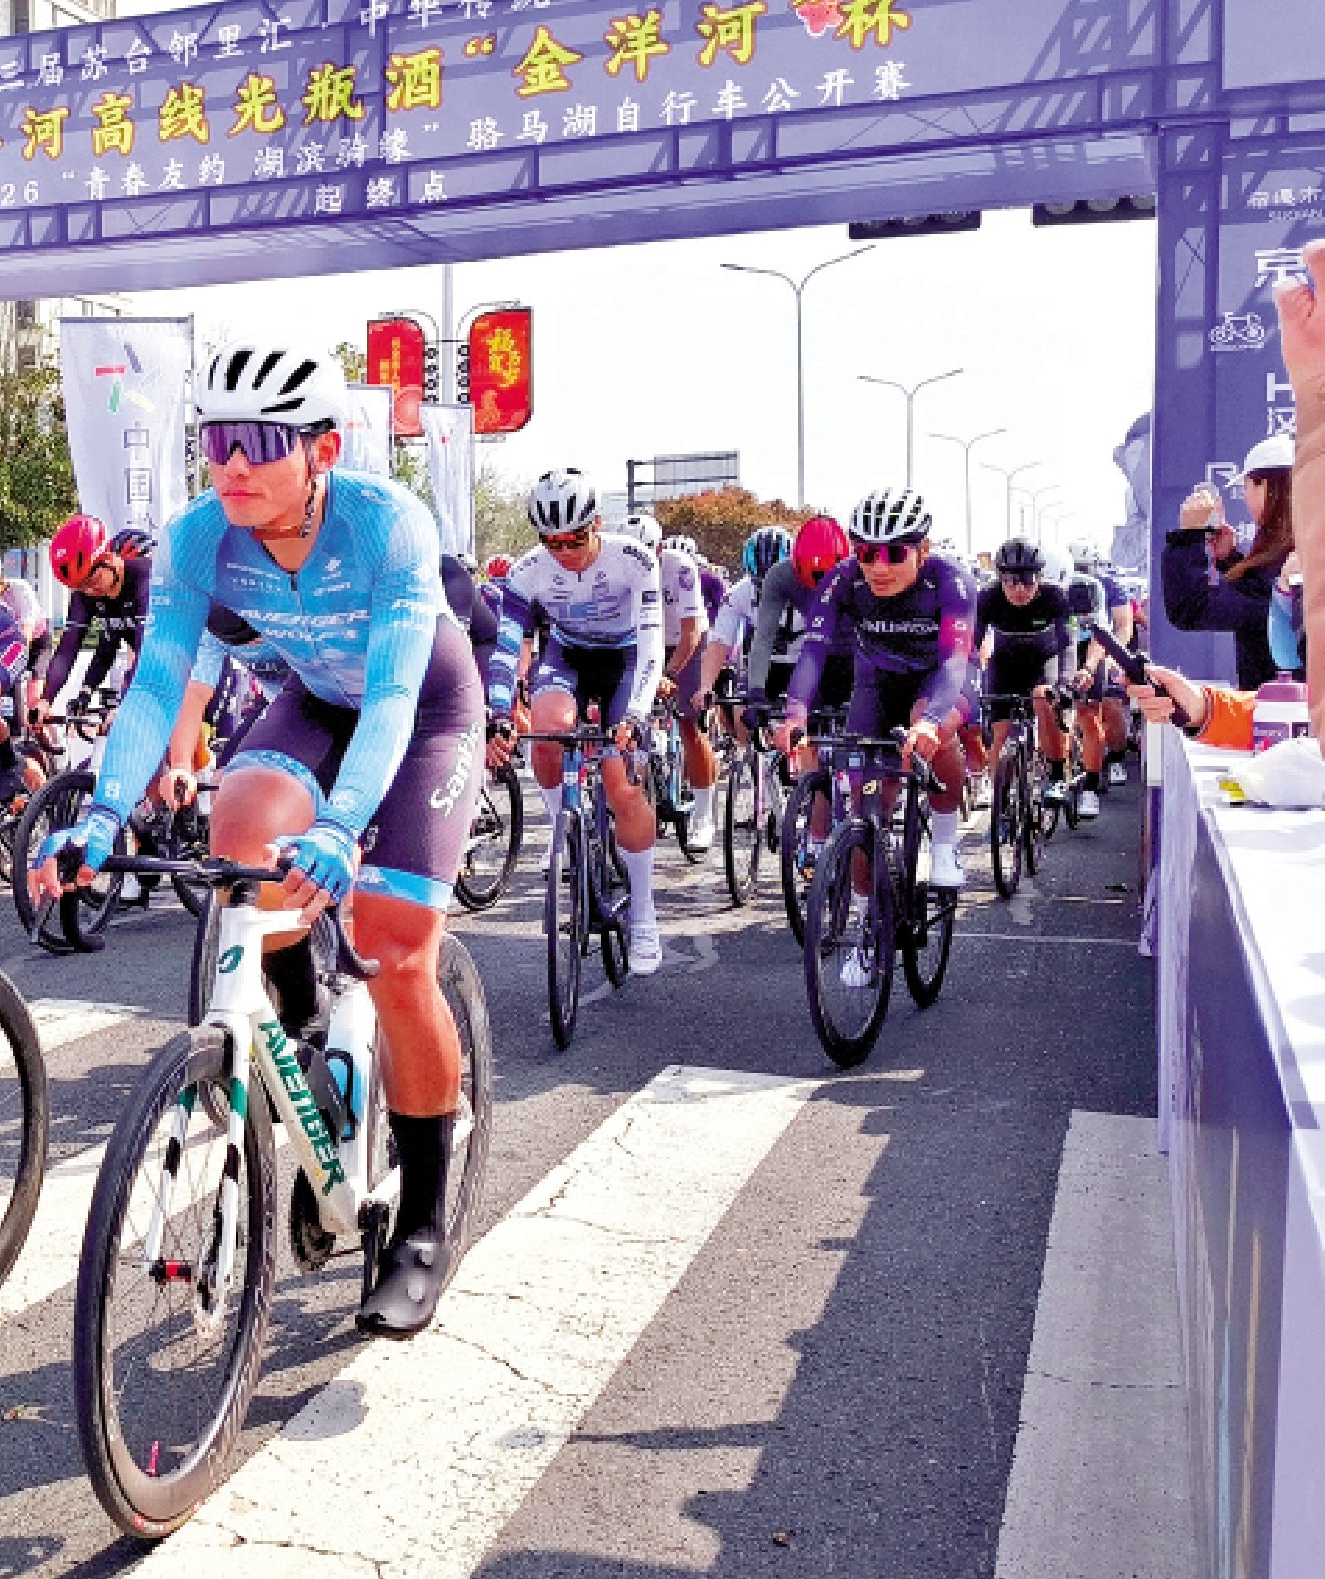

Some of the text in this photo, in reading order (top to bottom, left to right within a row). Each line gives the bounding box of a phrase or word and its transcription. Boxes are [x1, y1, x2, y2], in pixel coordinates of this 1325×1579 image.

[467, 60, 913, 150] 骆马湖自行车公开赛
[315, 170, 447, 215] 起终点
